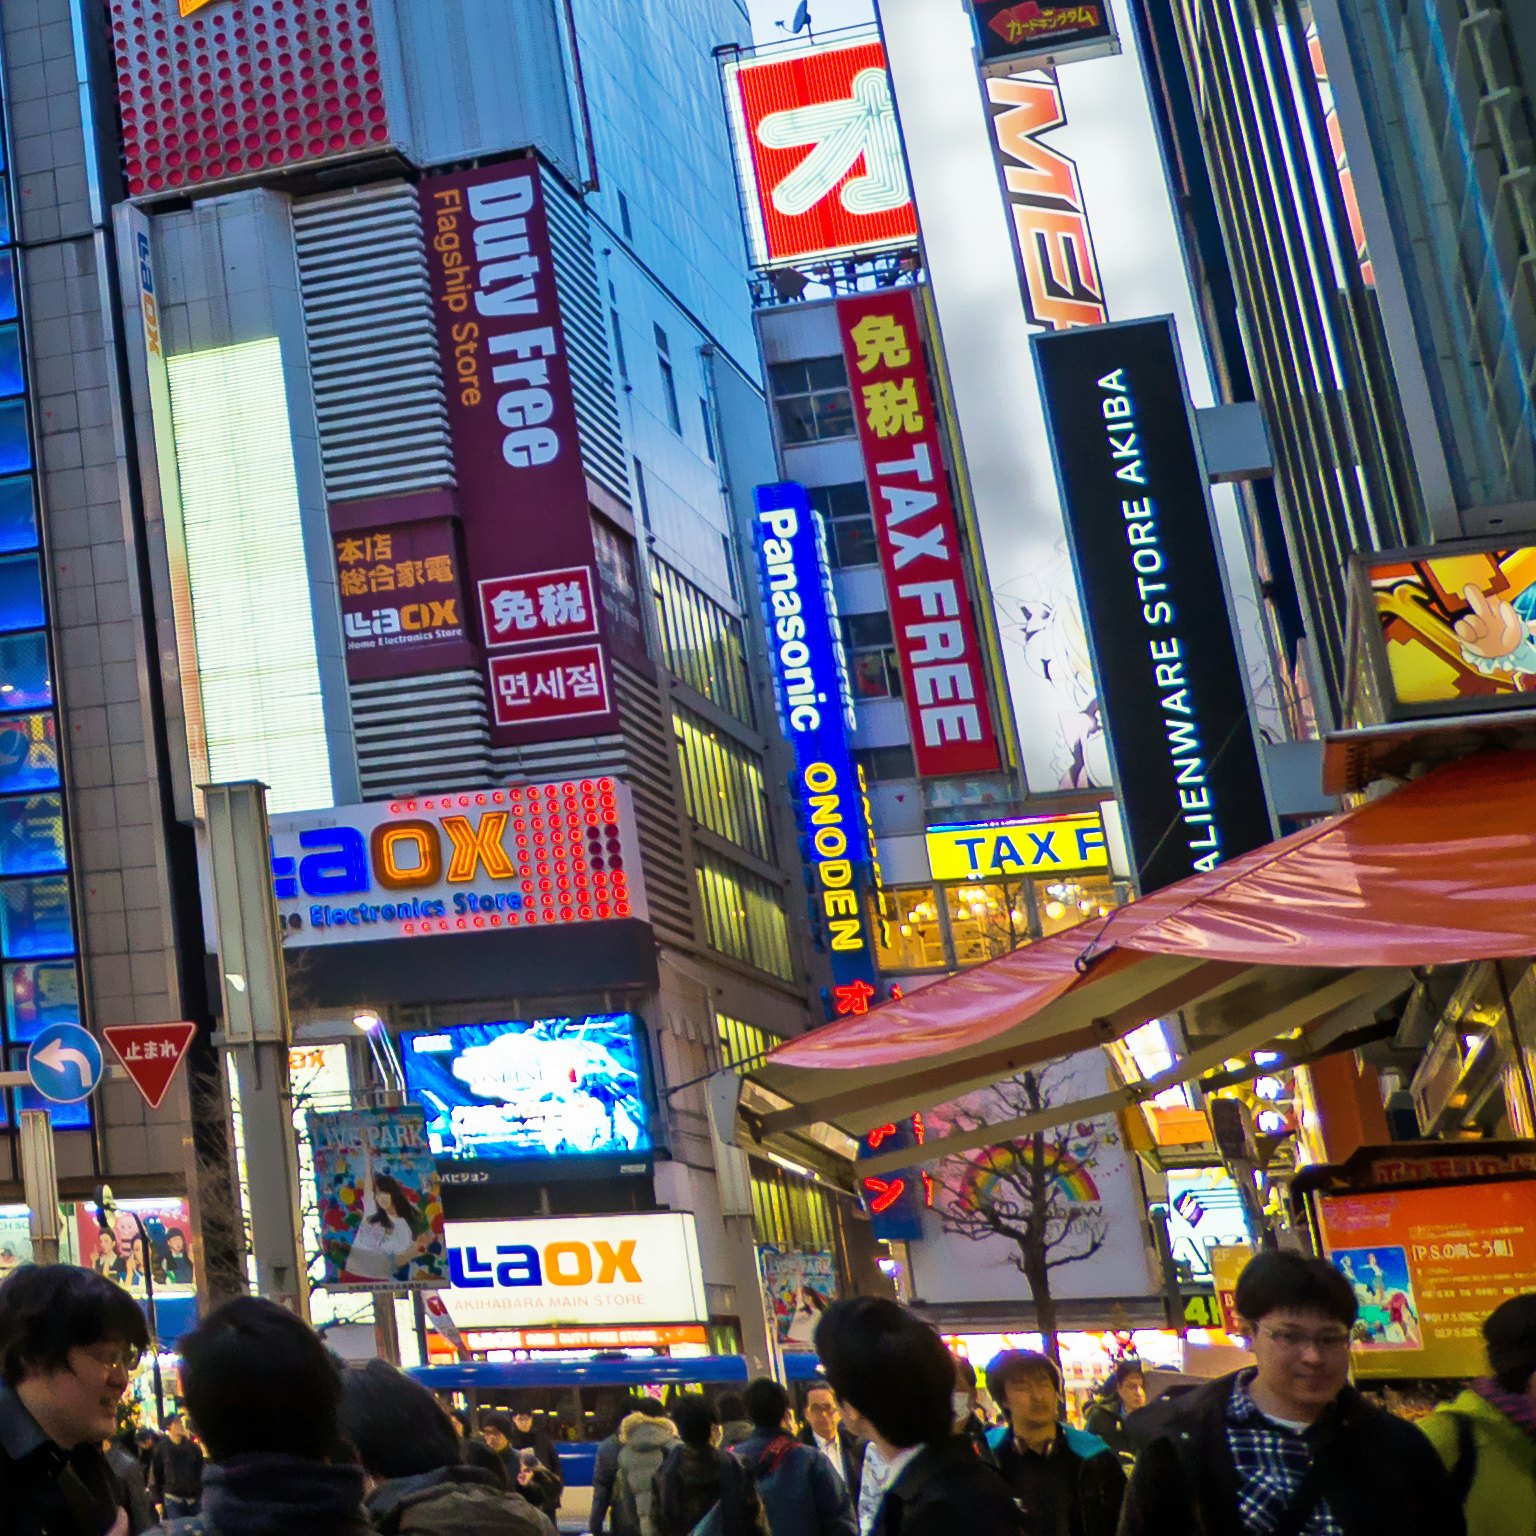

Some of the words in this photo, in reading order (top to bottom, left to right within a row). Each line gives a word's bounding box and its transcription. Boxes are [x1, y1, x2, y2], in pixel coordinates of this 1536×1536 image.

[432, 189, 472, 314] Flagship
[468, 173, 540, 319] Duty
[450, 321, 482, 407] Store
[487, 327, 561, 468] Free
[849, 313, 925, 440] 免税
[1097, 367, 1148, 485] AKIBA
[337, 531, 392, 565] 本店
[874, 441, 950, 571] TAX
[340, 554, 455, 597] 総合家電
[490, 581, 587, 634] 免税
[1122, 495, 1172, 626] STORE
[347, 636, 377, 652] Home
[377, 630, 434, 649] Electronics
[434, 626, 464, 641] Store
[758, 508, 829, 733] Panasonic
[898, 578, 982, 750] FREE
[497, 659, 604, 708] 면세점
[1149, 635, 1221, 873] ALIENWARE
[804, 762, 864, 952] ONODEN
[954, 830, 1062, 872] TAX
[310, 896, 448, 928] Electronics
[453, 890, 523, 916] Store
[124, 1040, 178, 1062] 止まれ
[369, 1123, 426, 1150] PARK
[454, 1297, 544, 1312] AKIHABARA
[549, 1295, 589, 1309] MAIN
[592, 1293, 647, 1308] STORE
